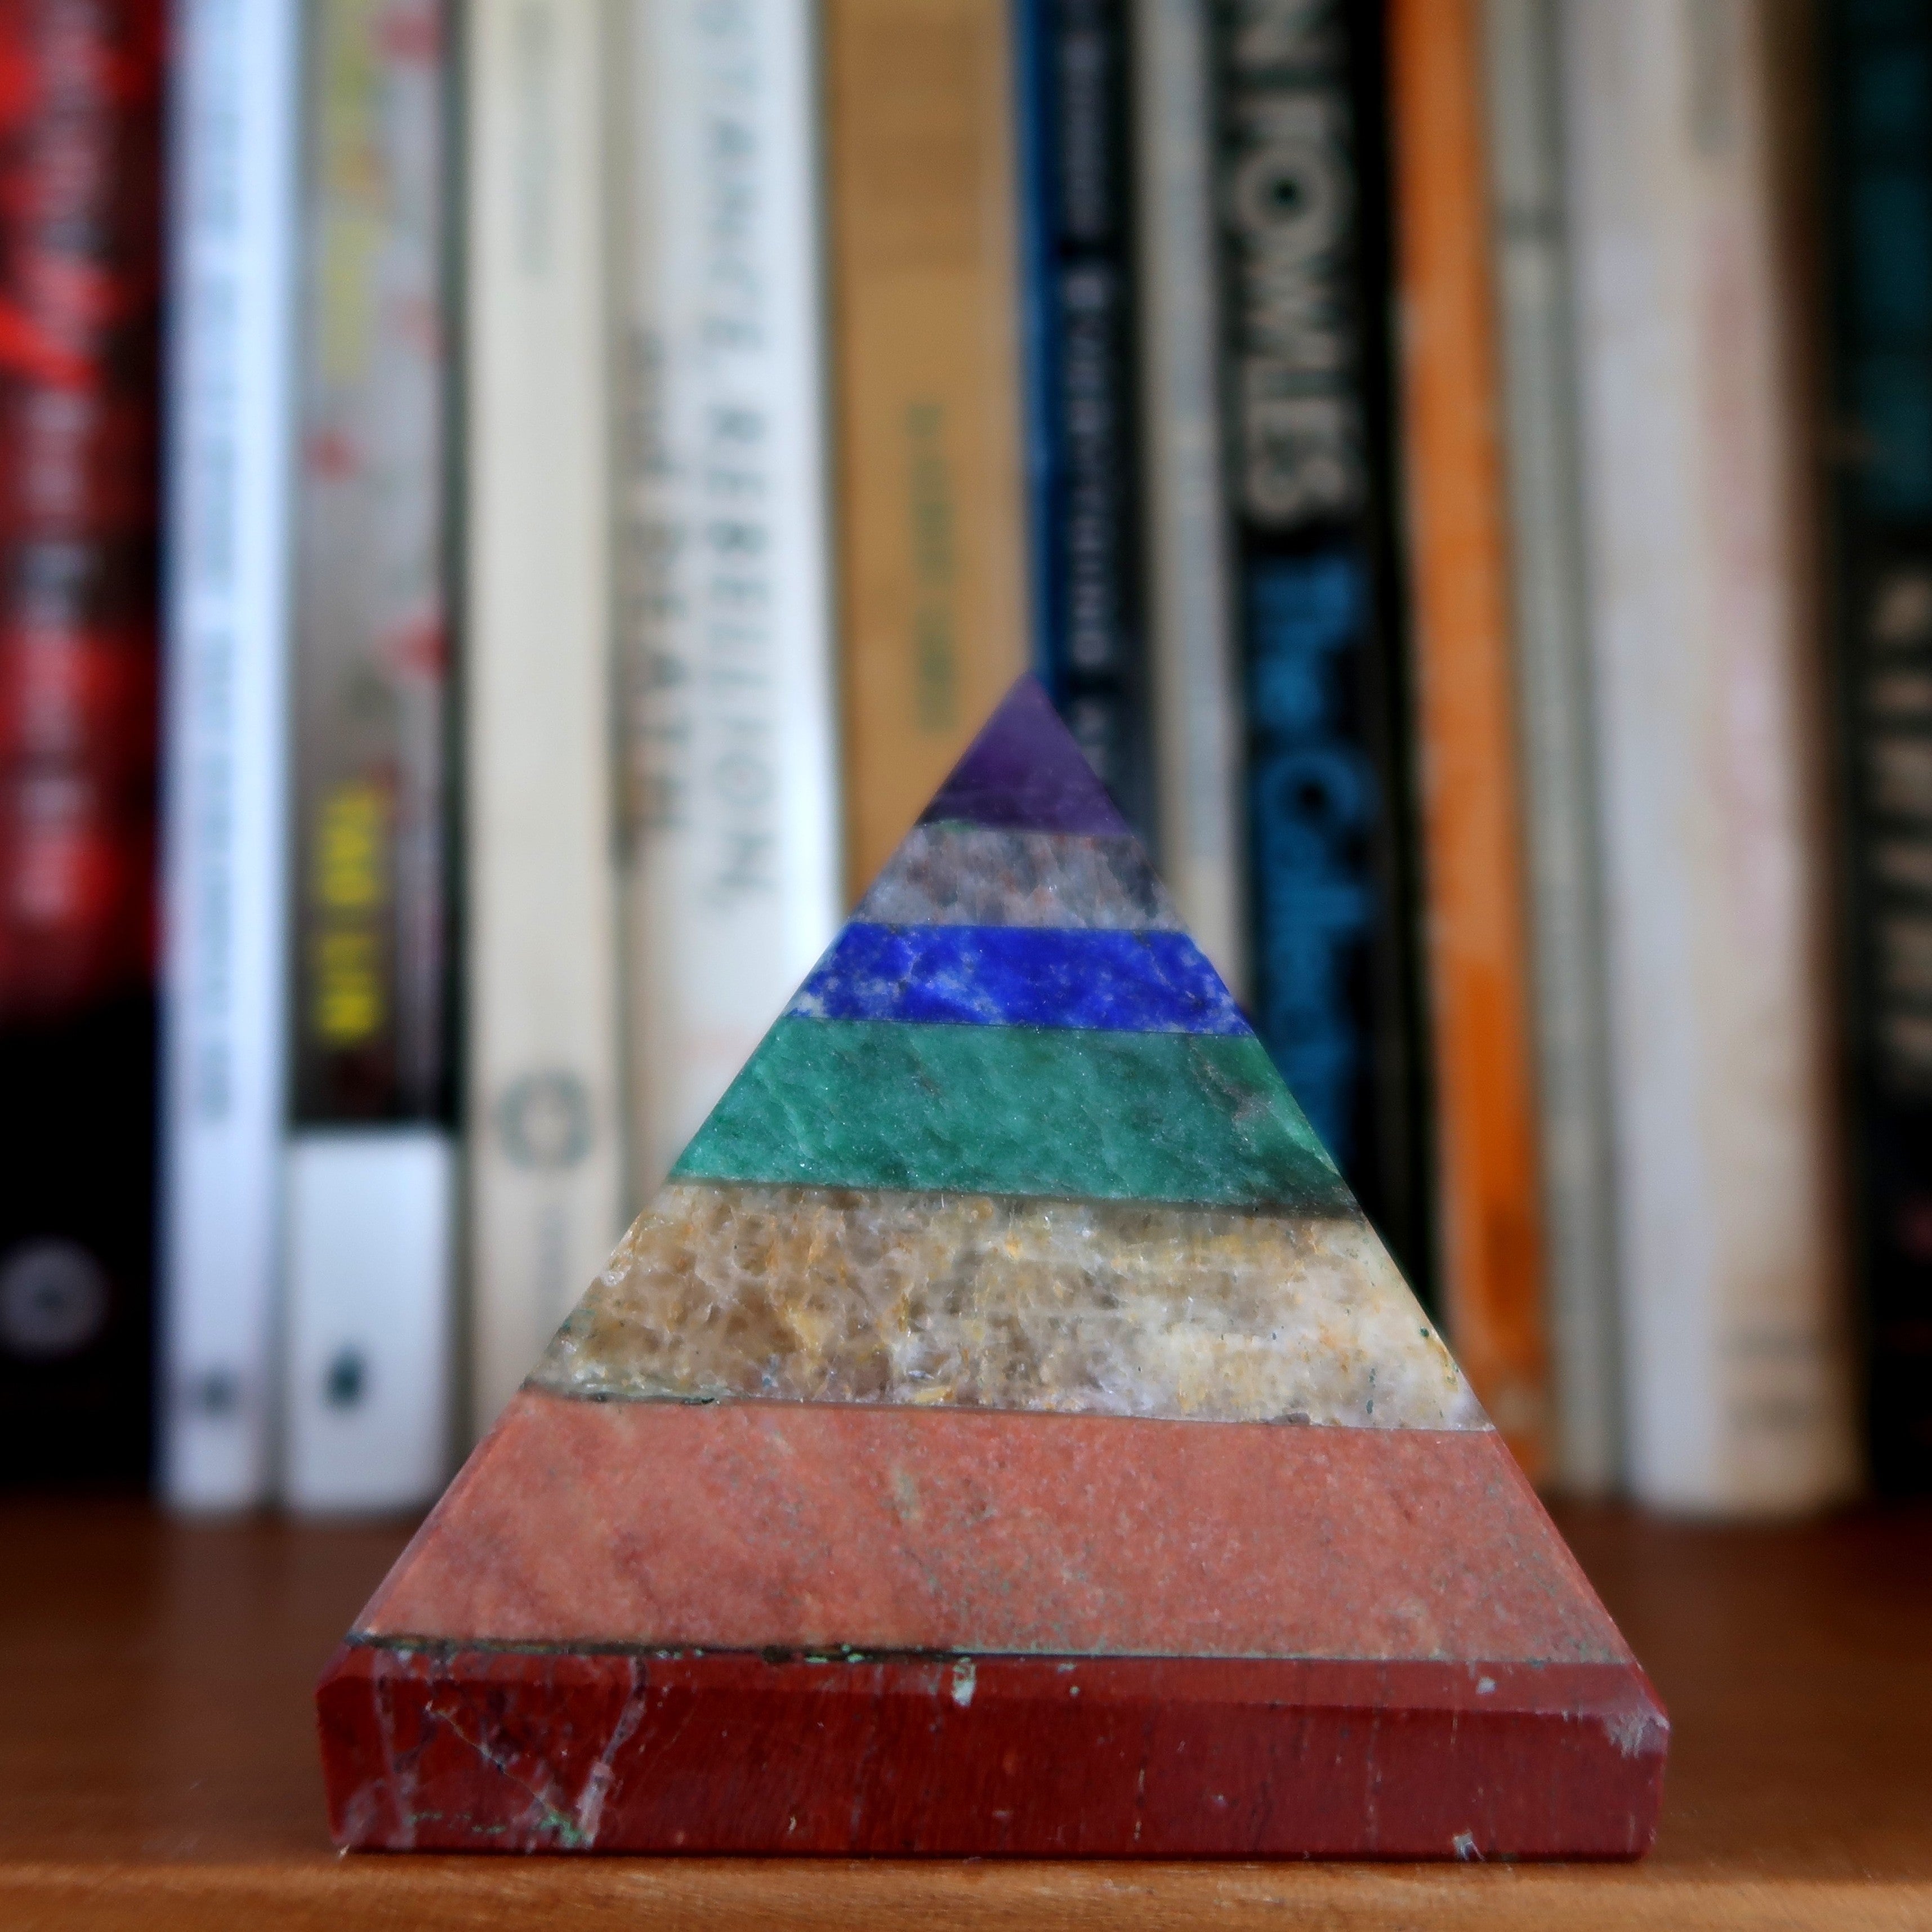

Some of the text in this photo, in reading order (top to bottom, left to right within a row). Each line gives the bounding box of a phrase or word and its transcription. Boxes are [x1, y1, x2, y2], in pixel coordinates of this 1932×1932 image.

[1236, 91, 1363, 525] FOWLES
[624, 519, 694, 832] DEATH
[1256, 555, 1367, 730] The
